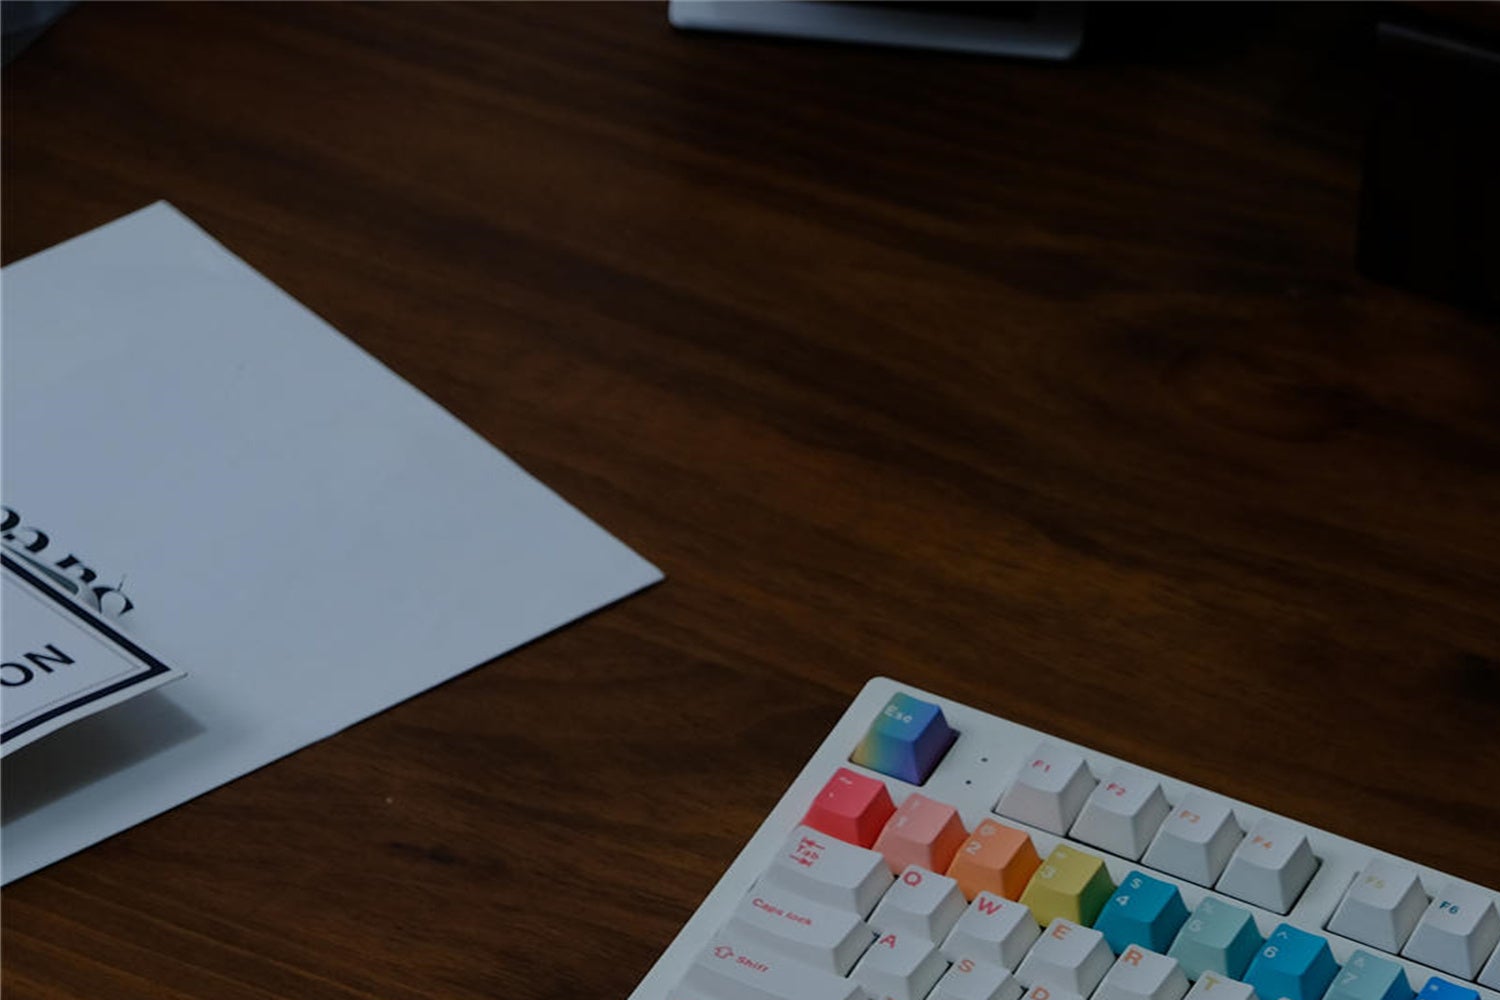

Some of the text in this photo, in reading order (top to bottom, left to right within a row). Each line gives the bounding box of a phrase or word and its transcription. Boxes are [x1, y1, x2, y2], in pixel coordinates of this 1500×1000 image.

[884, 705, 913, 724] Esc
[1032, 760, 1051, 773] F1
[1107, 783, 1126, 797] F2
[1180, 810, 1200, 823] F3
[1252, 836, 1272, 849] F4
[977, 897, 1002, 915] W
[1115, 894, 1131, 907] 4
[1439, 900, 1460, 915] F6
[1051, 924, 1072, 940] E
[879, 934, 897, 948] A
[1124, 949, 1144, 966] R
[1263, 946, 1280, 959] 6
[735, 955, 770, 973] Shift
[958, 959, 976, 973] S
[1205, 976, 1221, 990] T
